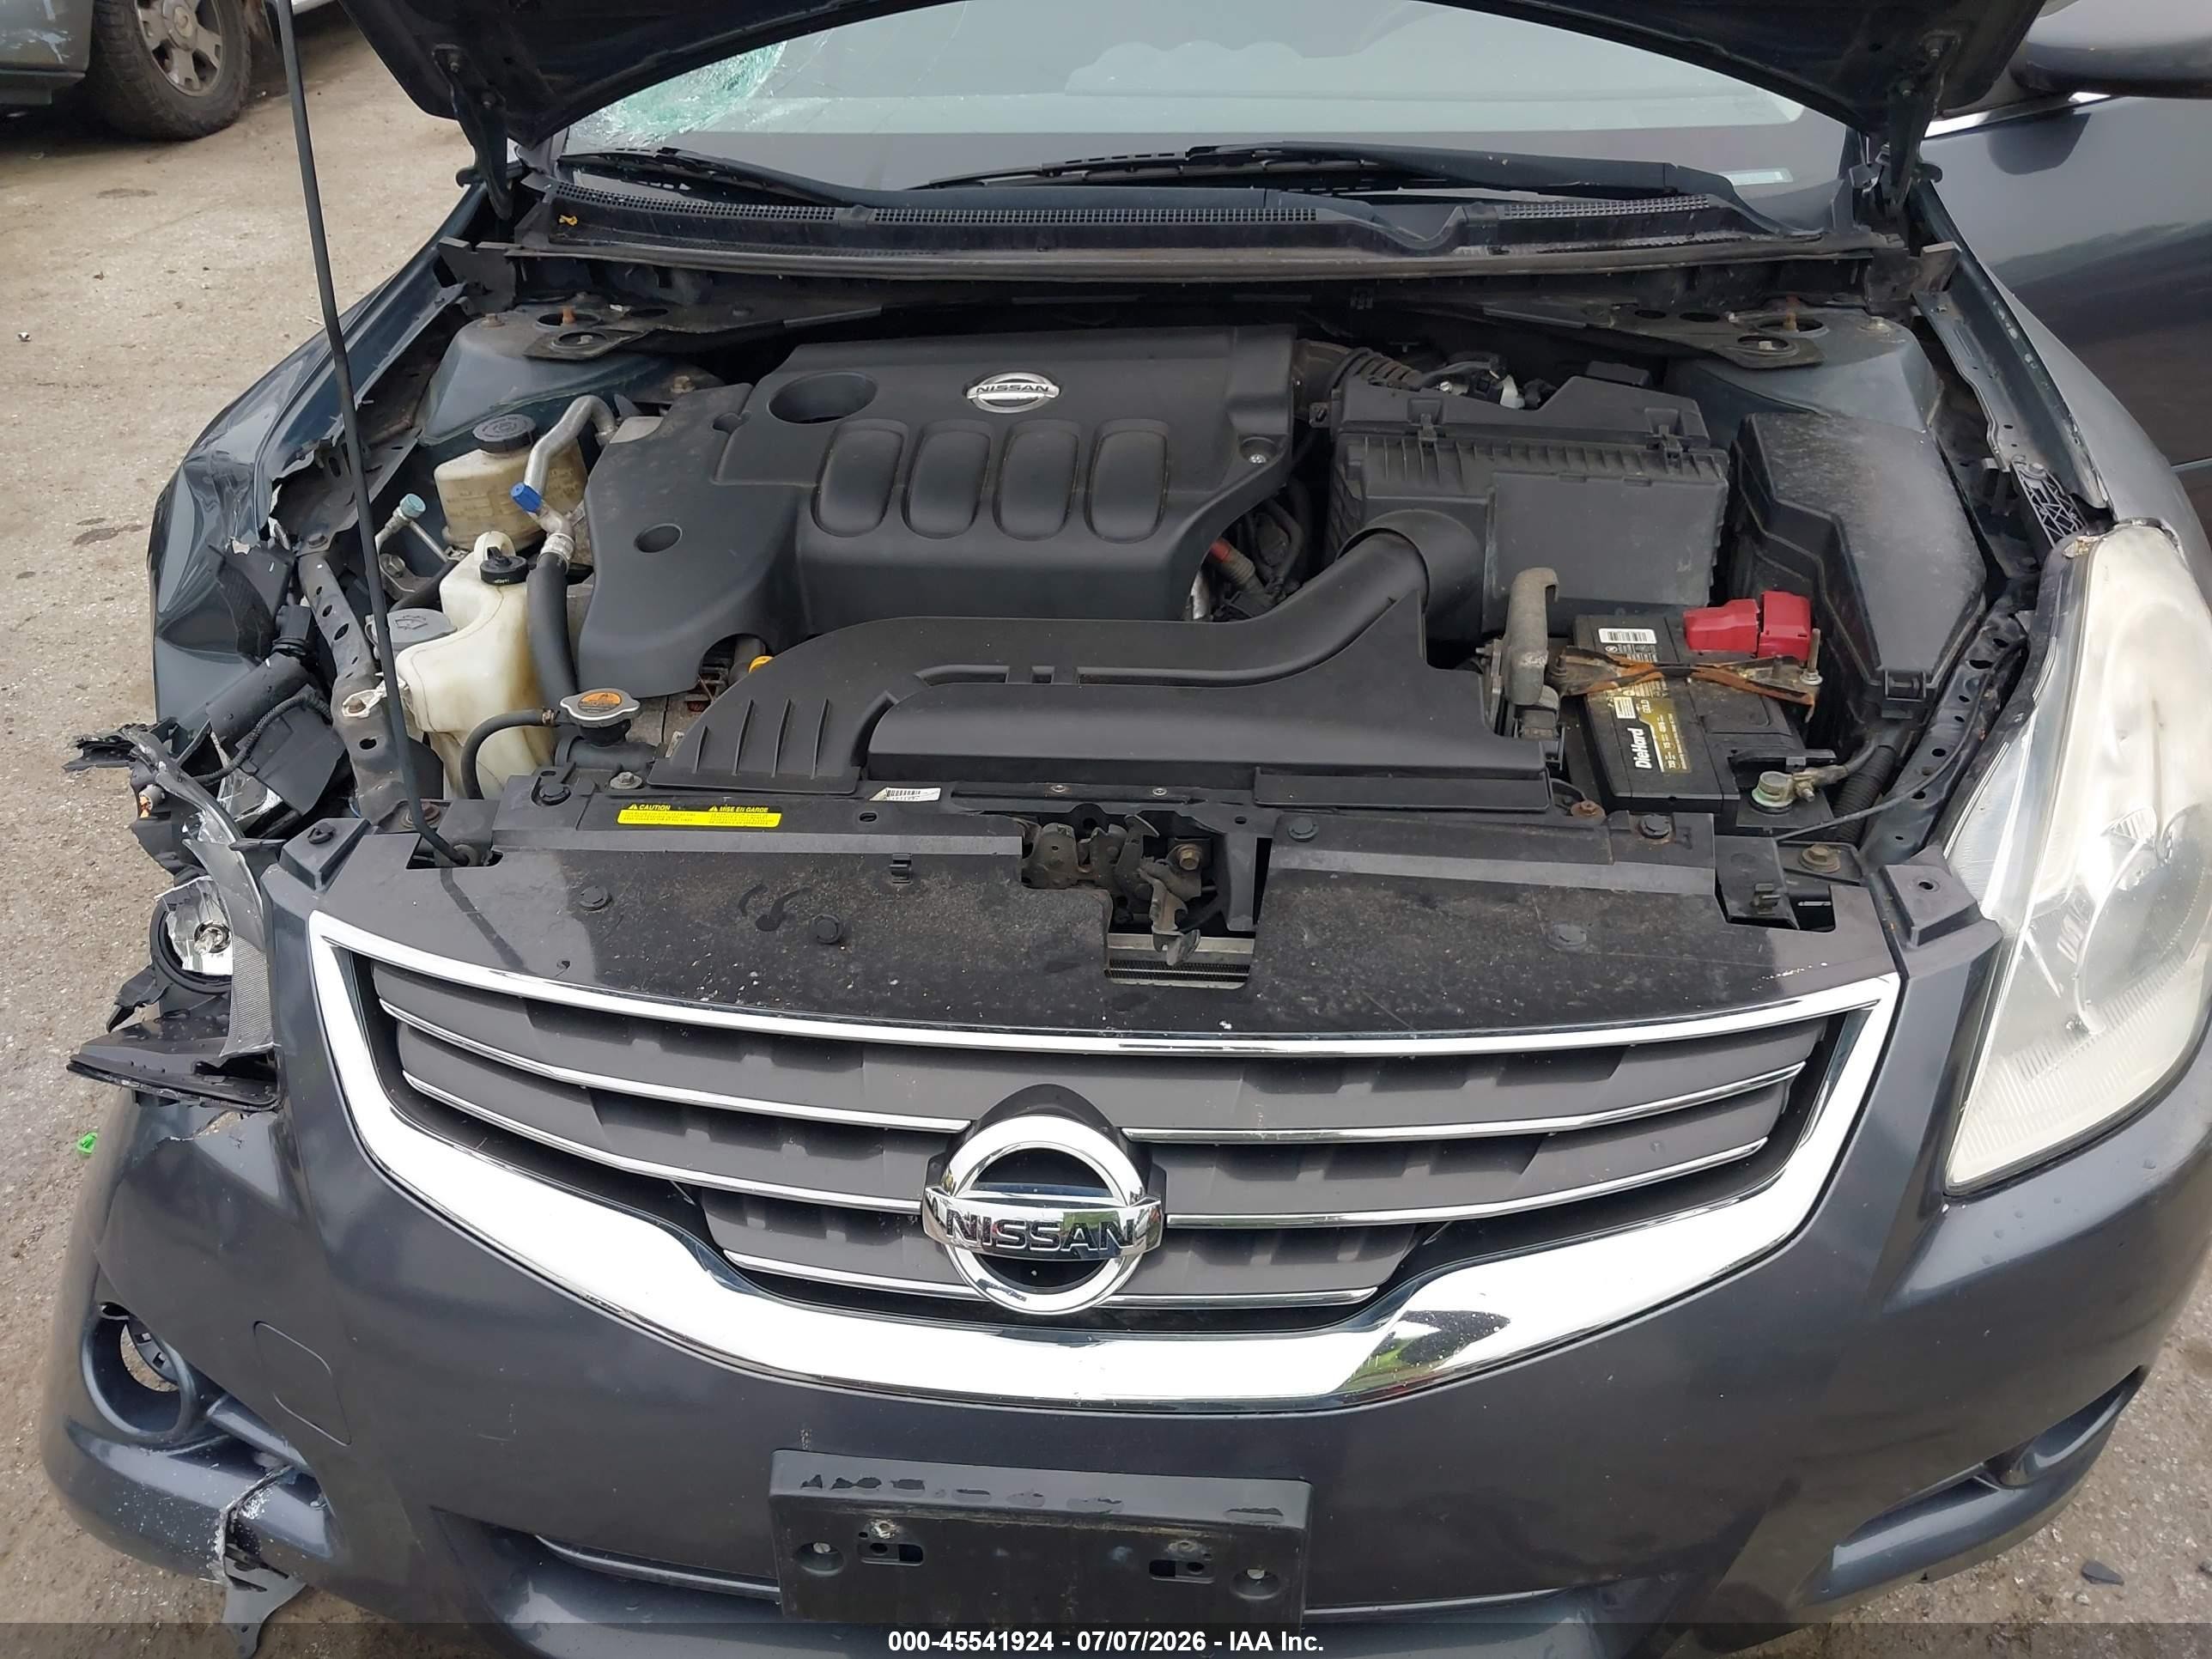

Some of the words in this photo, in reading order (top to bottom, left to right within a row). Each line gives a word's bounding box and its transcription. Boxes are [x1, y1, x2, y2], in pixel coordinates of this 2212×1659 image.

[975, 384, 1049, 392] NISSAN
[1627, 727, 1652, 769] DieHard
[945, 1208, 1136, 1253] NISSAN
